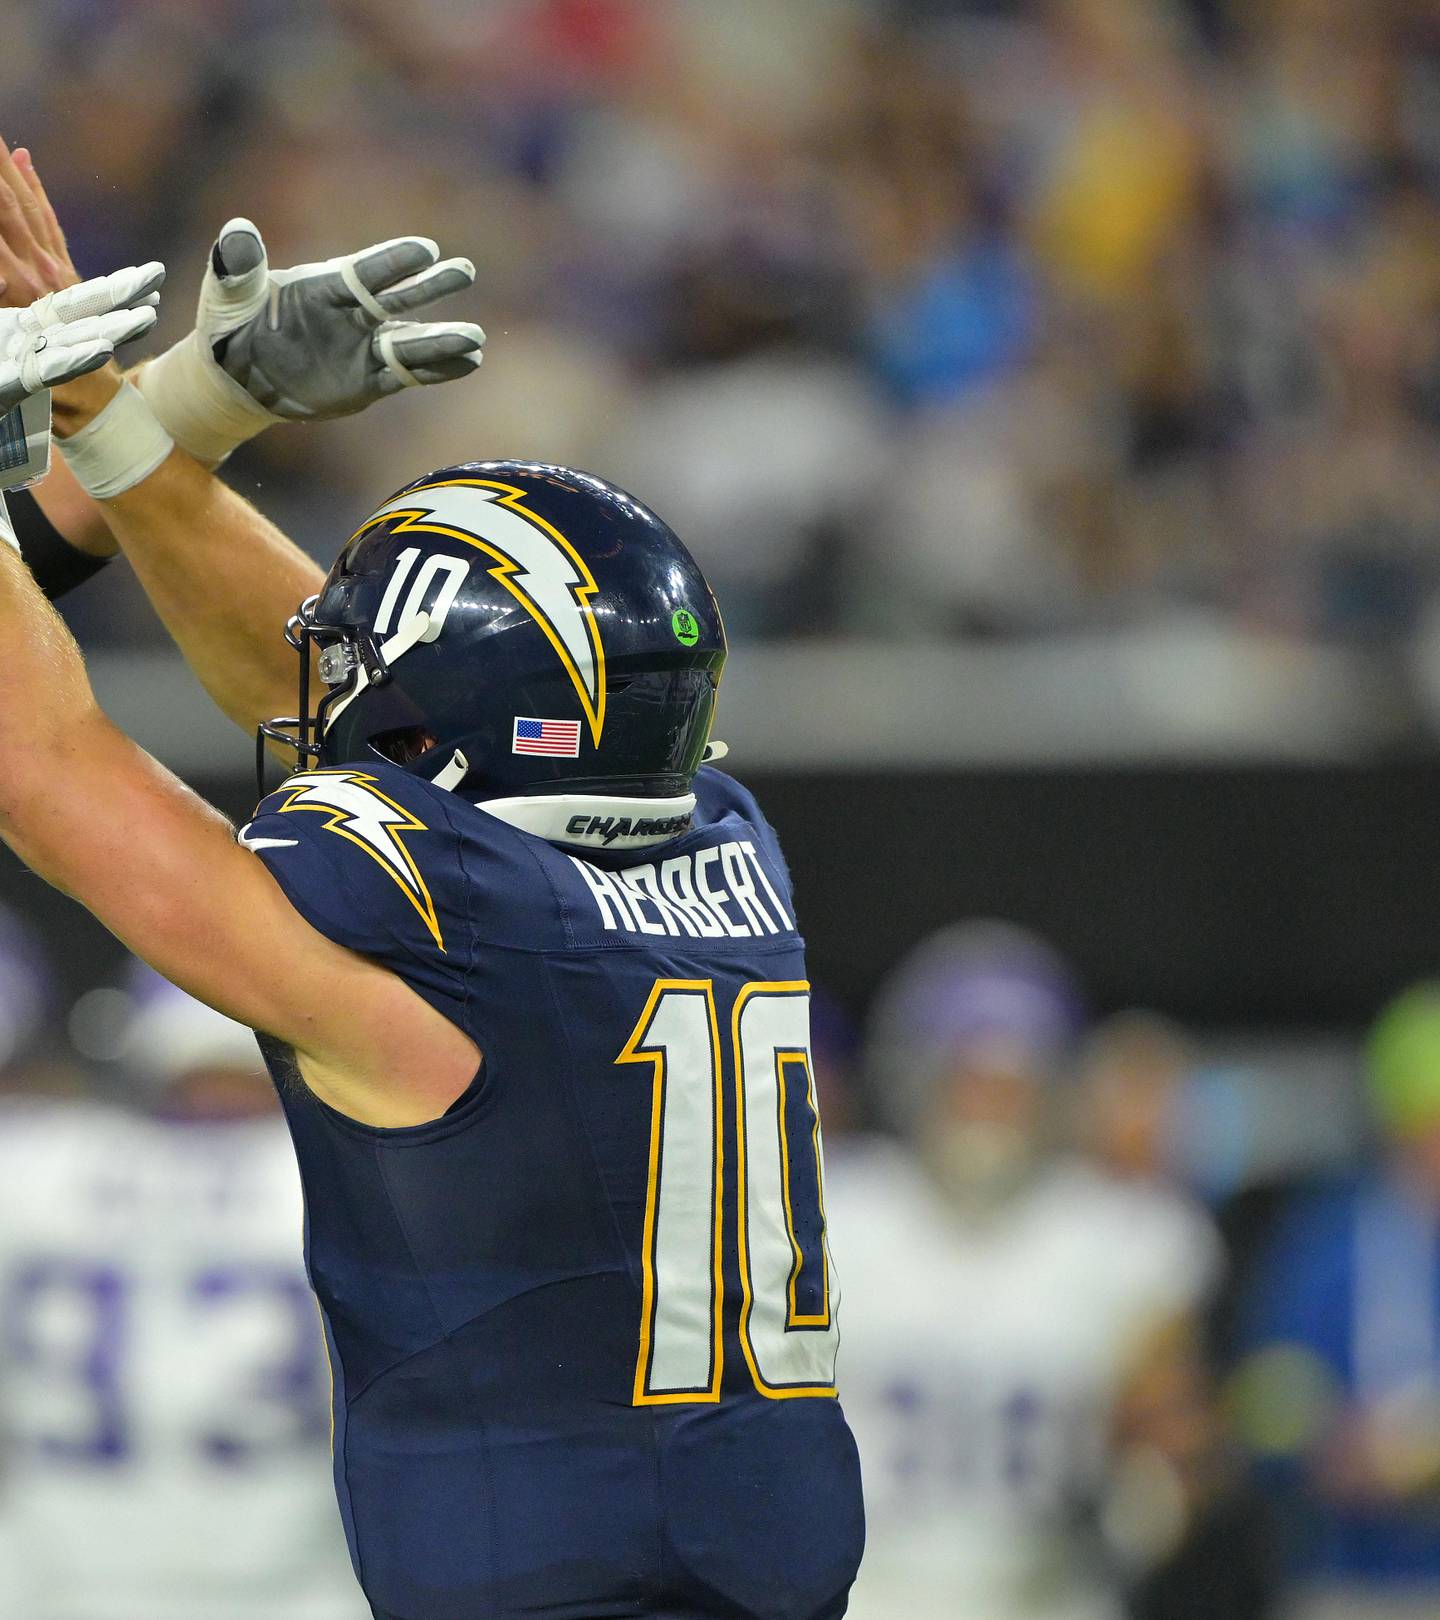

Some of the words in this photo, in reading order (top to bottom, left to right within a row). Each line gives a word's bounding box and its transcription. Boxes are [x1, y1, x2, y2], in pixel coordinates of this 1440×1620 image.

[373, 547, 470, 643] 10
[567, 841, 794, 938] HERBERT
[614, 979, 841, 1406] 10
